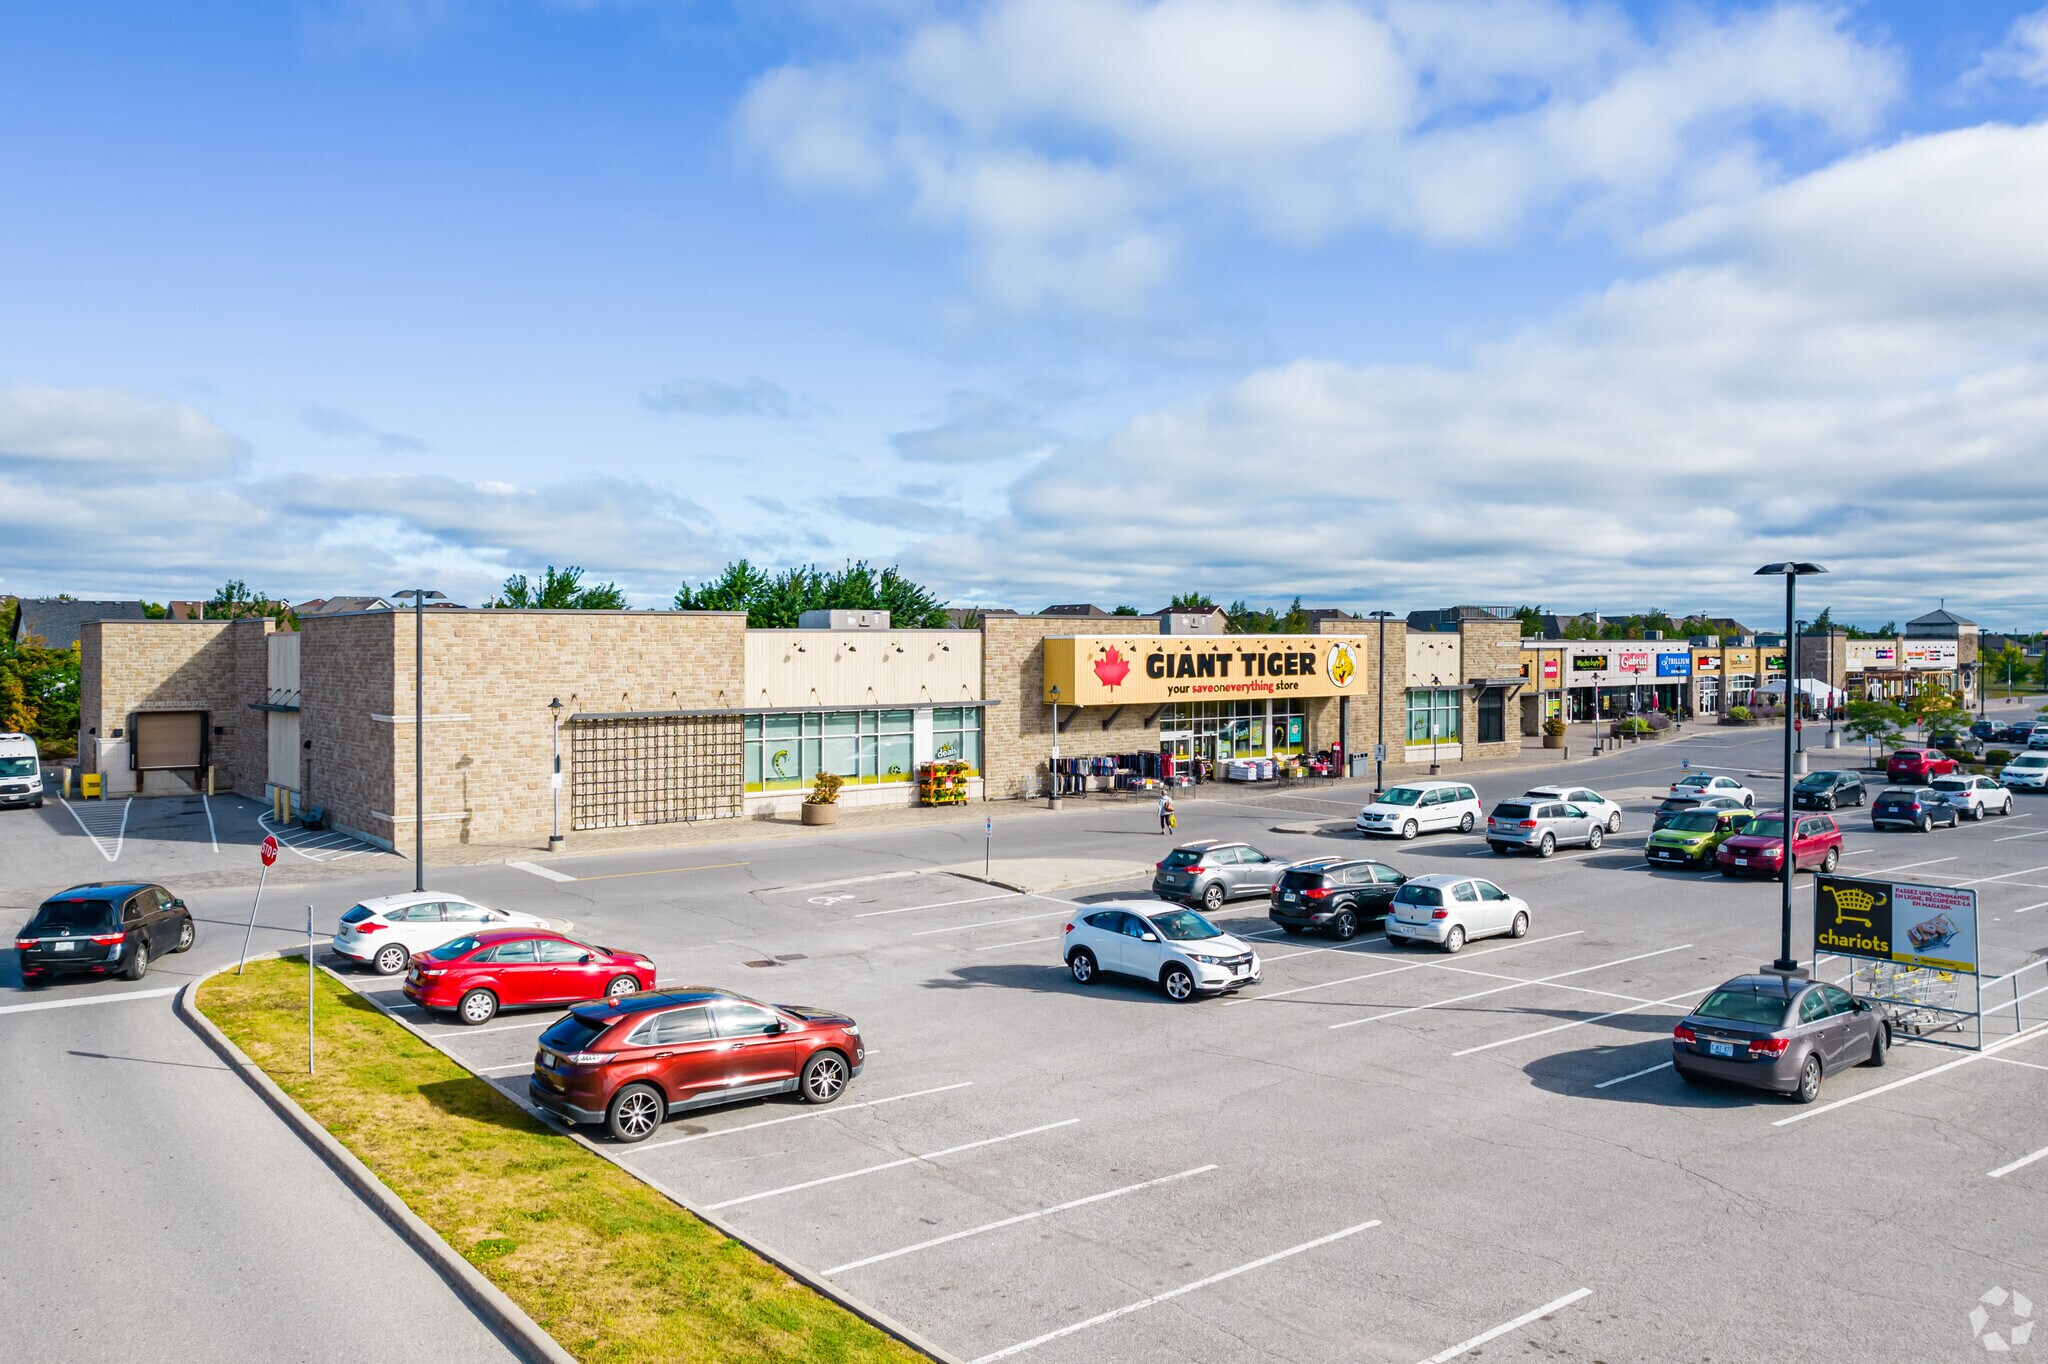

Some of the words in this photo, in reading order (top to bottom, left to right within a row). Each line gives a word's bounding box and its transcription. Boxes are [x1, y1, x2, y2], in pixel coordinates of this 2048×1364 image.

[1146, 652, 1233, 679] GIANT
[1241, 652, 1317, 677] TIGER
[1621, 655, 1647, 669] Gabriel
[1668, 657, 1690, 665] TRILLIUM
[1167, 685, 1190, 697] your
[1192, 680, 1274, 694] saveoneverything
[1275, 680, 1299, 691] store
[261, 842, 278, 859] STOP
[1895, 887, 1918, 895] PASSEZ
[1933, 892, 1970, 902] COMMANDE
[1818, 928, 1889, 952] chariots
